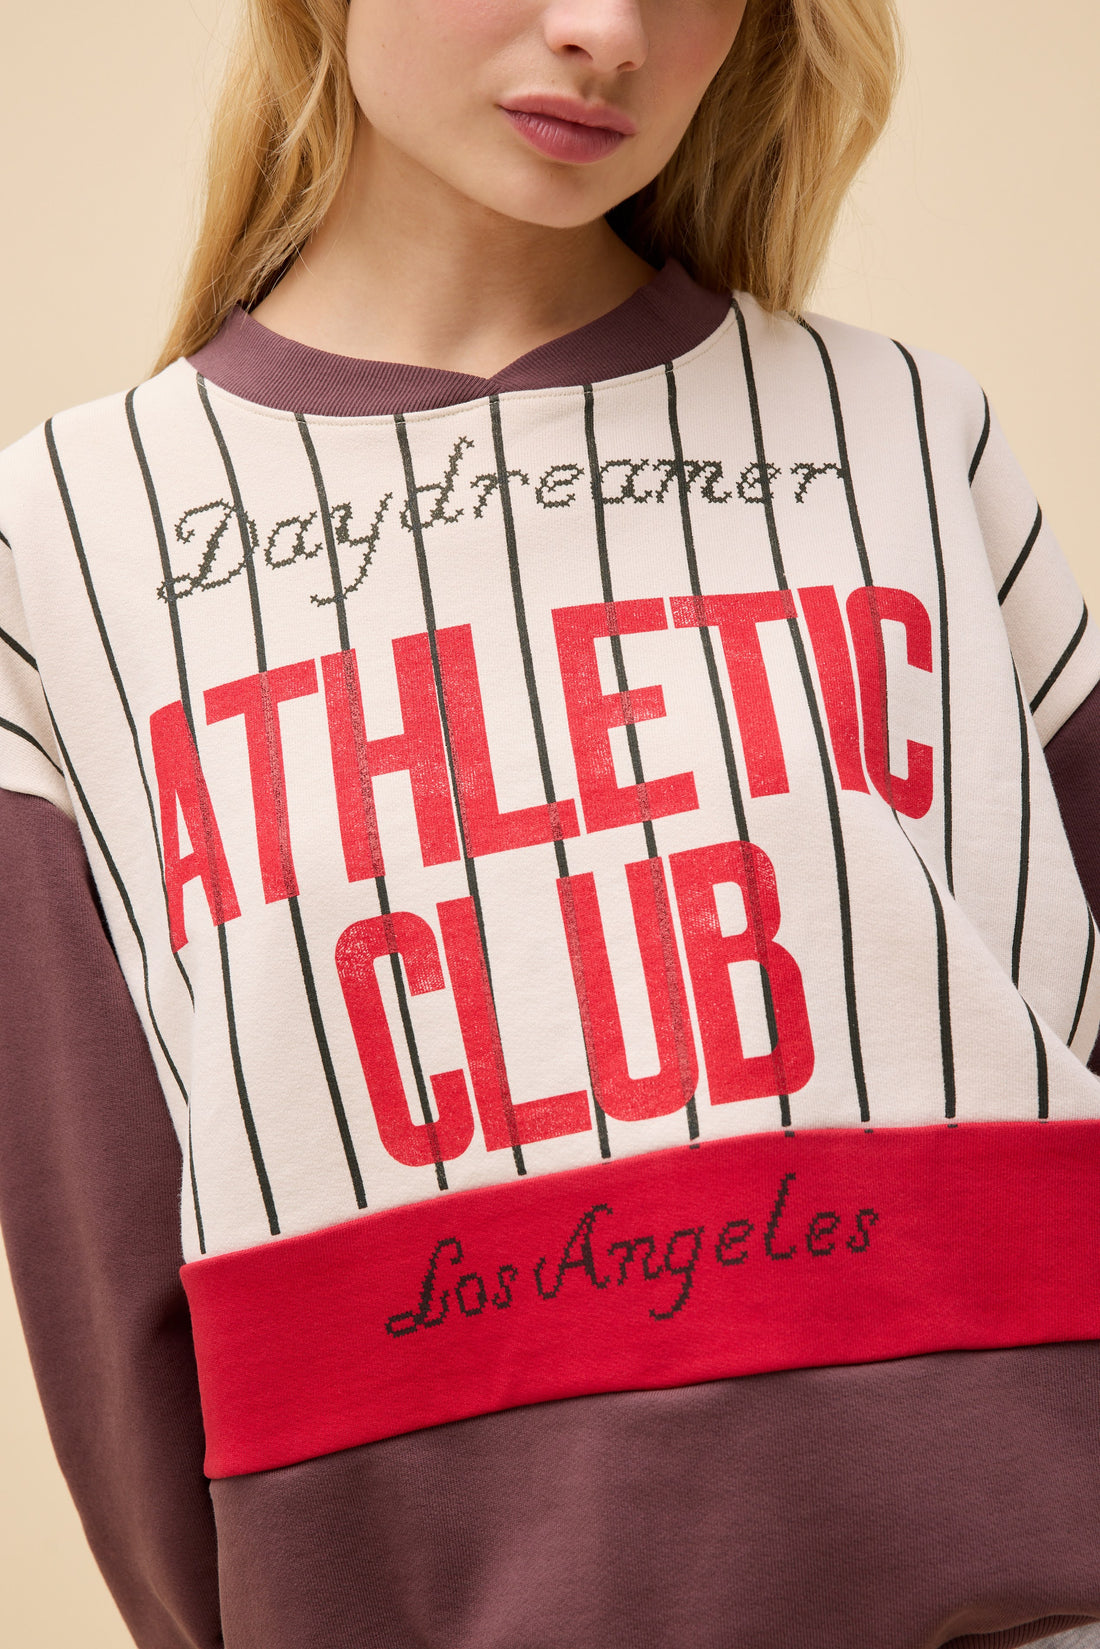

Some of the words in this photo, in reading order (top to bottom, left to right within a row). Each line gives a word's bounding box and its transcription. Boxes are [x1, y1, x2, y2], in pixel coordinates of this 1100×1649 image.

[157, 437, 846, 607] Daydreamer
[149, 585, 934, 954] ATHLETIC
[334, 840, 816, 1168] CLUB
[384, 1237, 518, 1337] Los
[534, 1172, 879, 1320] Angeles
